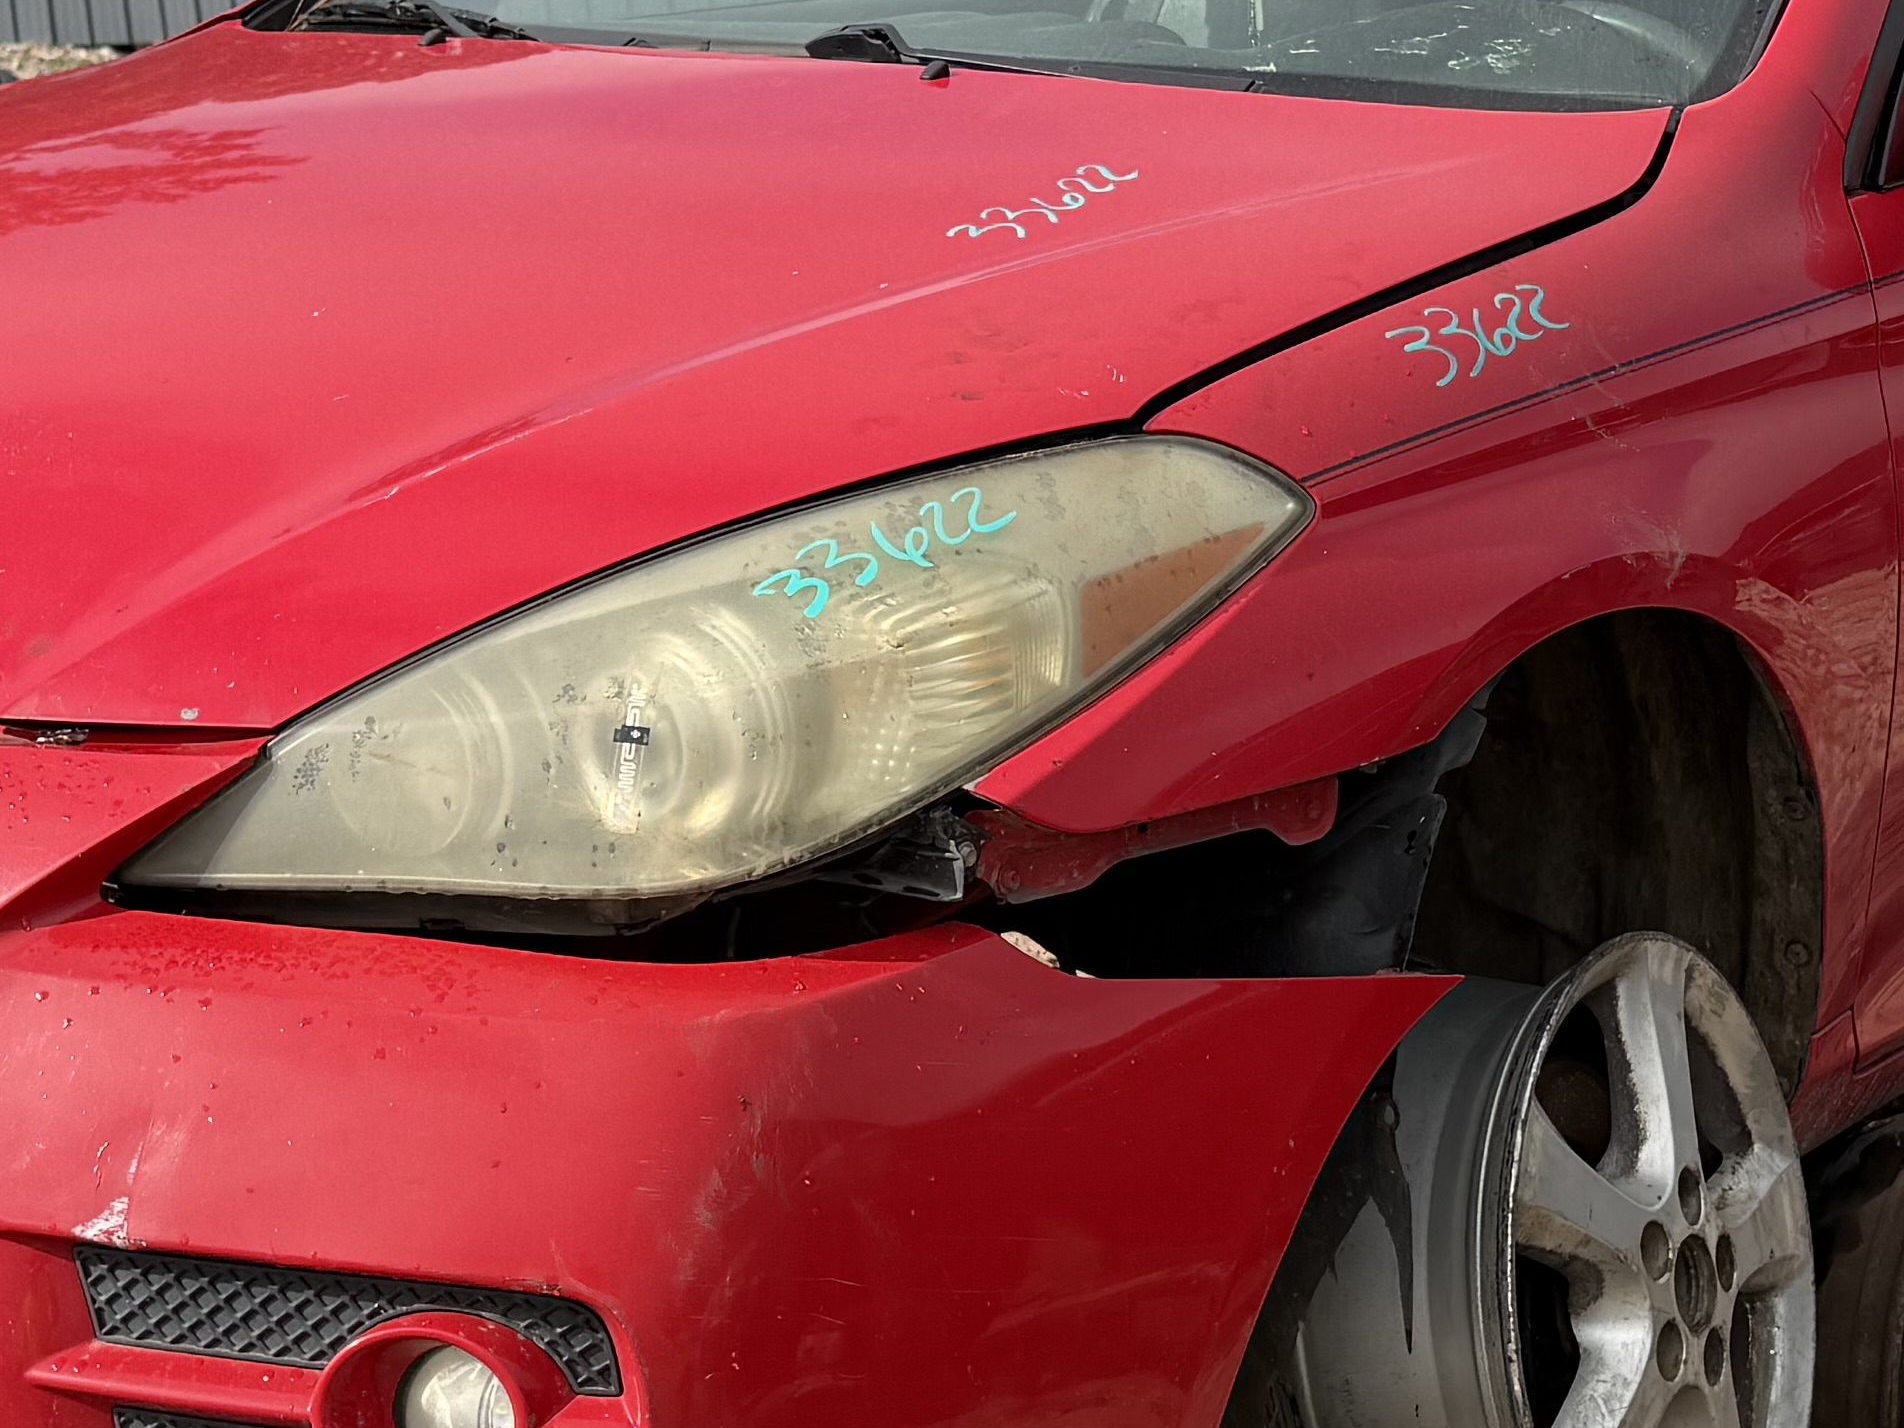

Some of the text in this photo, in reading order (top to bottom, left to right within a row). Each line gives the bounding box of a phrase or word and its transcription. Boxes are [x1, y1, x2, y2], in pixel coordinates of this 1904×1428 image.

[946, 164, 1139, 239] 33622
[1384, 283, 1571, 388] 33622
[752, 486, 1018, 619] 33622
